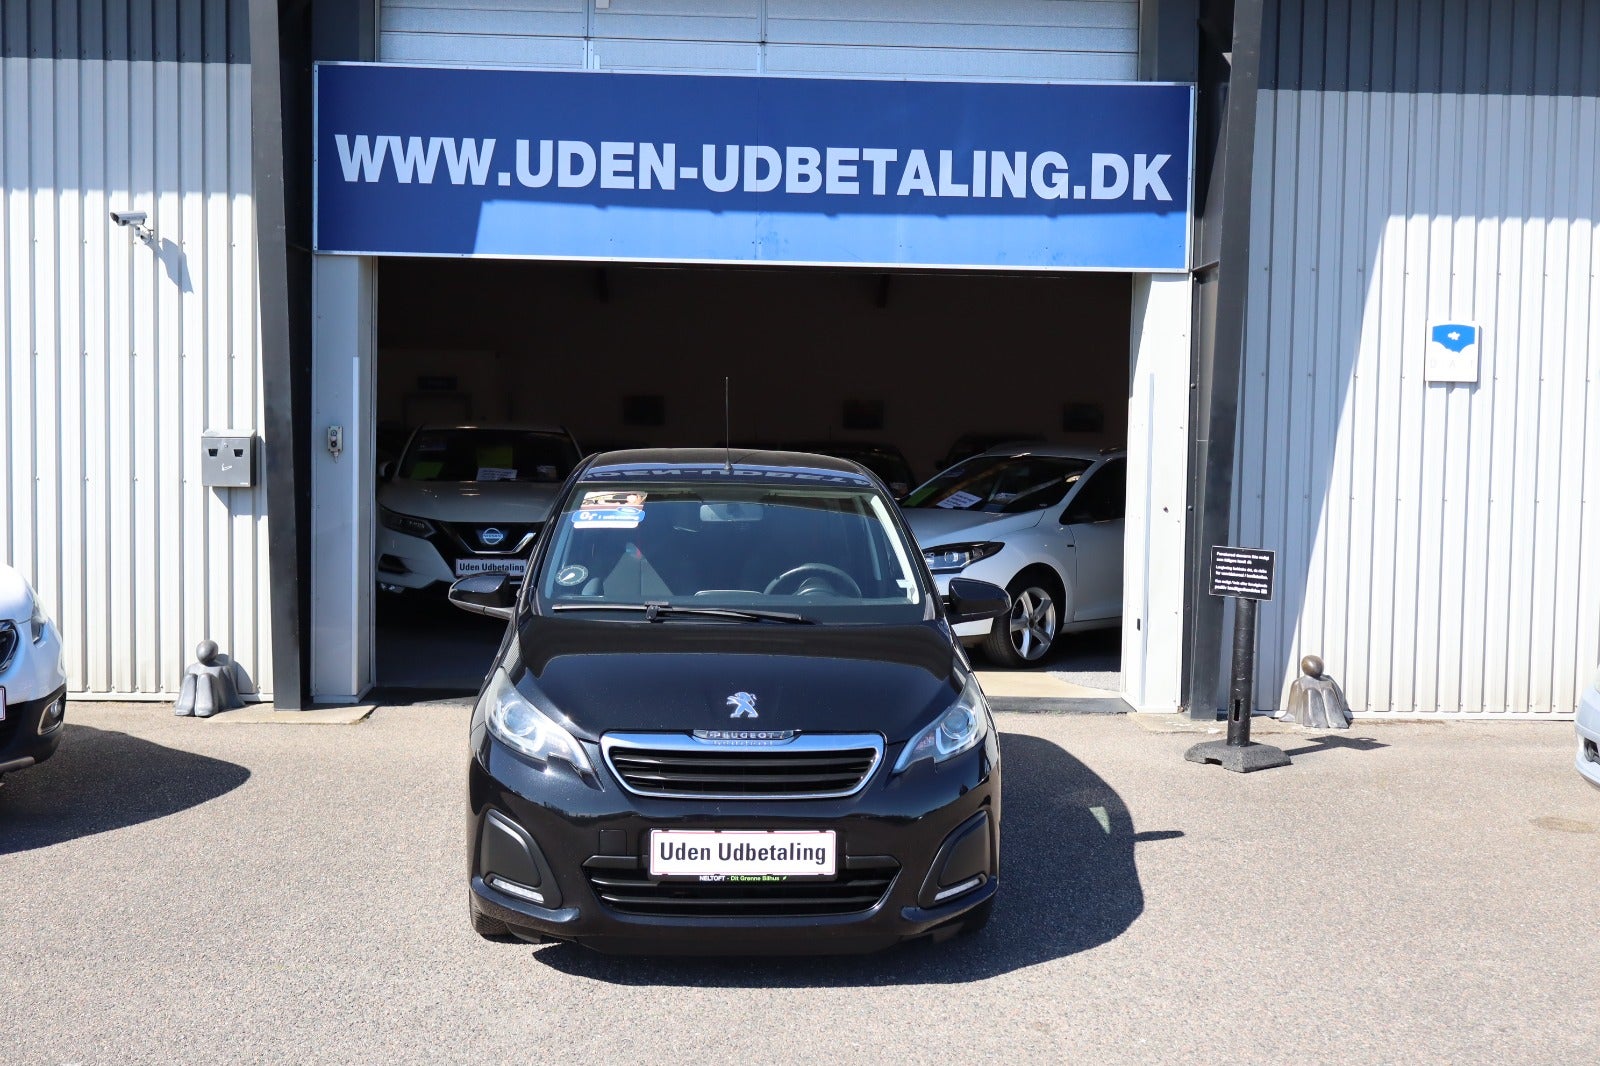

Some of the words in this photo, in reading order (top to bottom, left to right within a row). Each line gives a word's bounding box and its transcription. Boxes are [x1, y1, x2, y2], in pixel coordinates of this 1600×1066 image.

[334, 134, 1173, 201] WWW.UDEN-UDBETALING.DK
[459, 563, 480, 571] Uden
[481, 563, 525, 573] Udbetaling
[709, 731, 775, 739] PEUGEOT
[660, 842, 711, 861] Uden
[718, 842, 826, 865] Udbetaling
